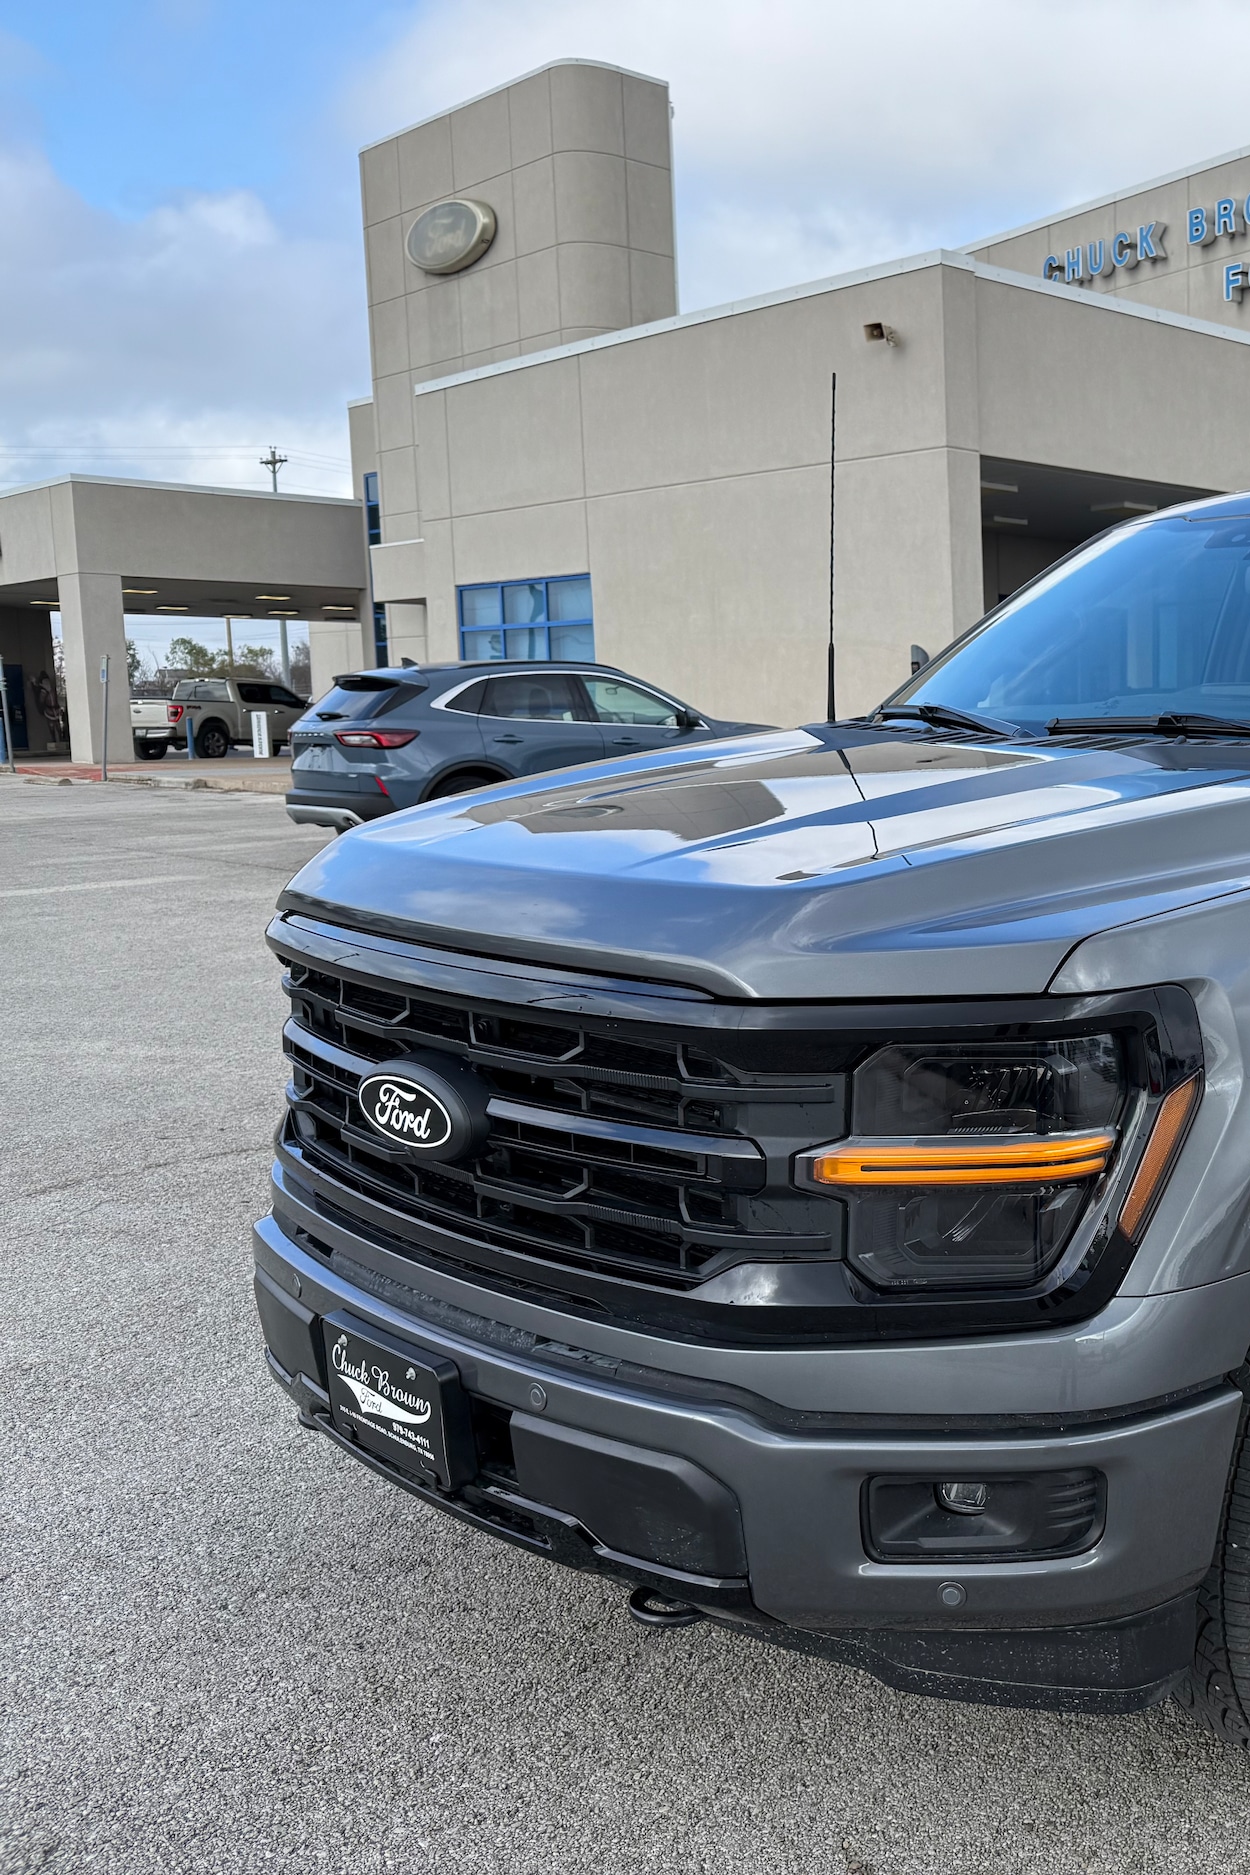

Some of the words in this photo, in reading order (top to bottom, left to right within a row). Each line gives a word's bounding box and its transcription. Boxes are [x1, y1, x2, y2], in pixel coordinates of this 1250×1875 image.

[1043, 221, 1164, 282] CHUCK
[375, 1083, 432, 1140] Ford
[332, 1343, 370, 1385] Chuck
[371, 1365, 431, 1413] Brown
[360, 1387, 382, 1414] Ford
